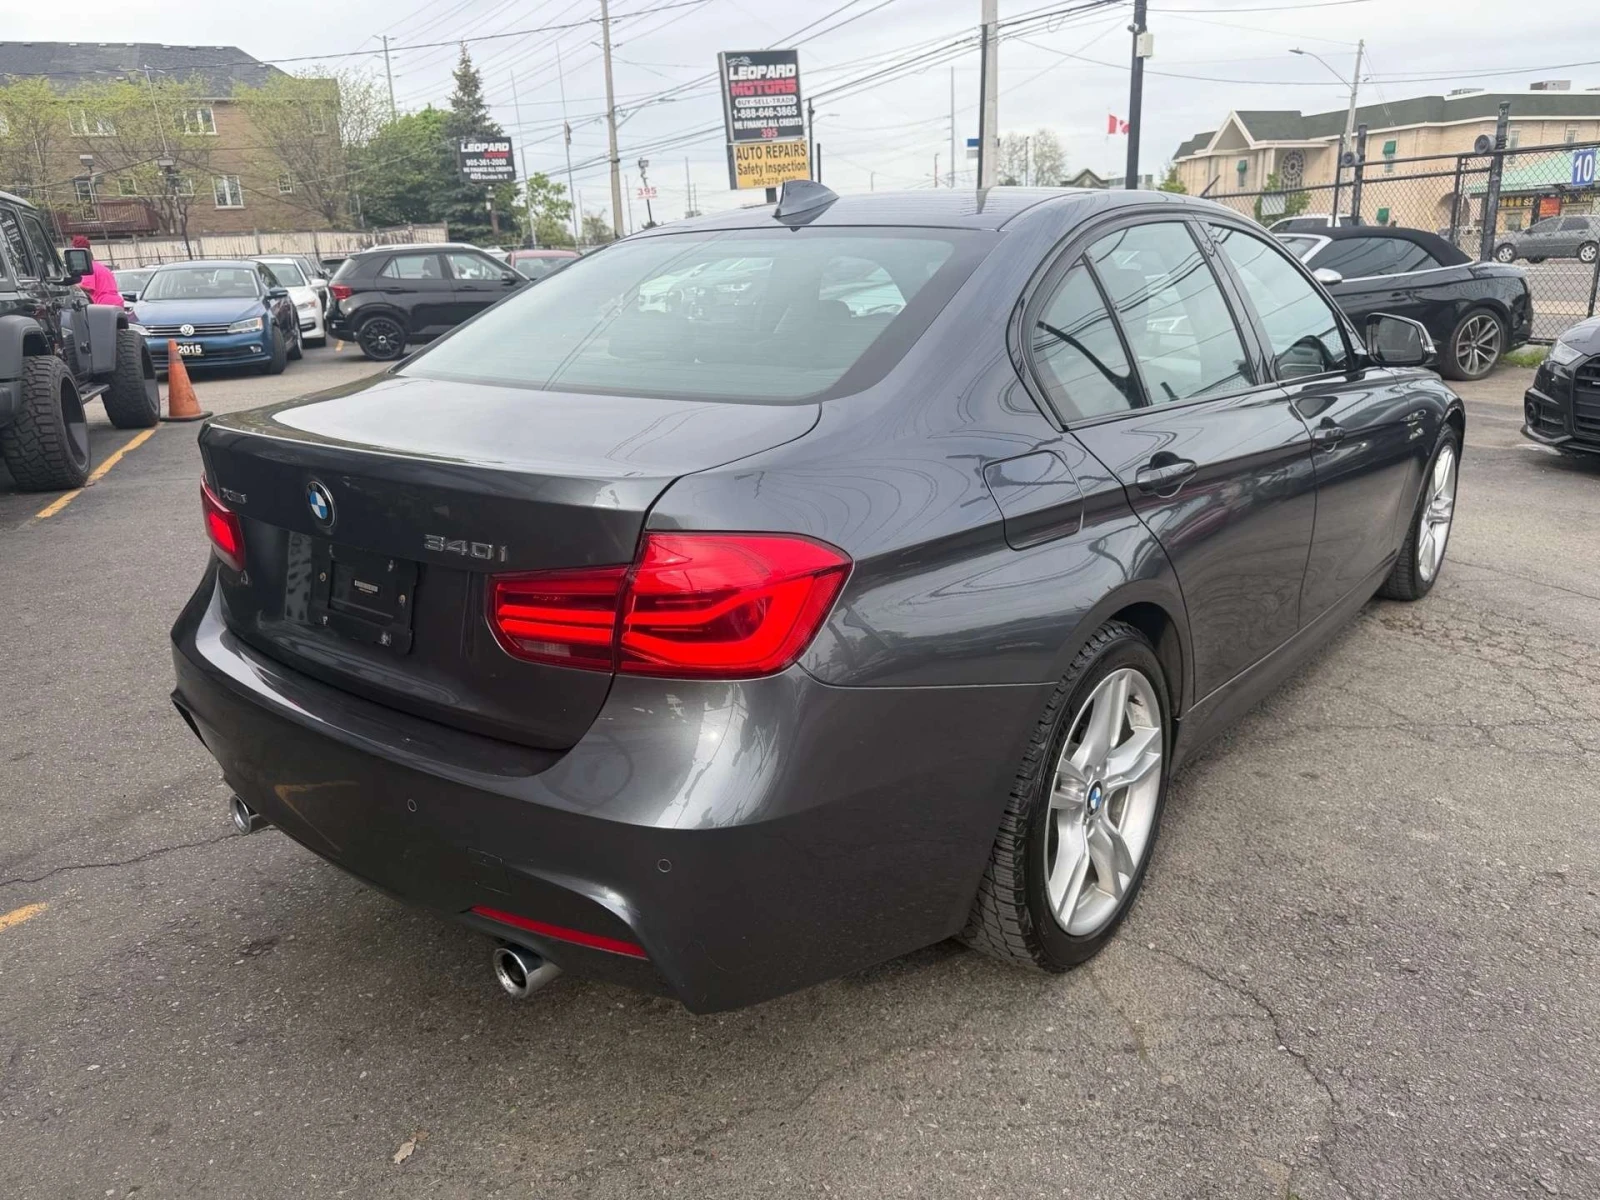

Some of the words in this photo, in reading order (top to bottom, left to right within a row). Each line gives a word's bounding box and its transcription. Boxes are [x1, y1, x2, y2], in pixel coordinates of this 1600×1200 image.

[729, 64, 795, 80] LEOPARD
[731, 79, 796, 95] MOTORS
[733, 106, 797, 119] 1-888-646-3865
[734, 121, 744, 130] WE
[744, 119, 768, 129] FINANCE
[768, 118, 779, 128] ALL
[779, 117, 803, 127] CREDITS
[761, 128, 778, 137] 395
[461, 142, 509, 153] LEOPARD
[736, 147, 763, 161] AUTO
[766, 145, 806, 158] REPAIRS
[737, 161, 764, 178] Safety
[765, 159, 807, 176] Inspection
[1575, 154, 1593, 183] 10
[637, 186, 657, 196] 395
[177, 344, 202, 354] 2015
[424, 533, 508, 562] 340i
